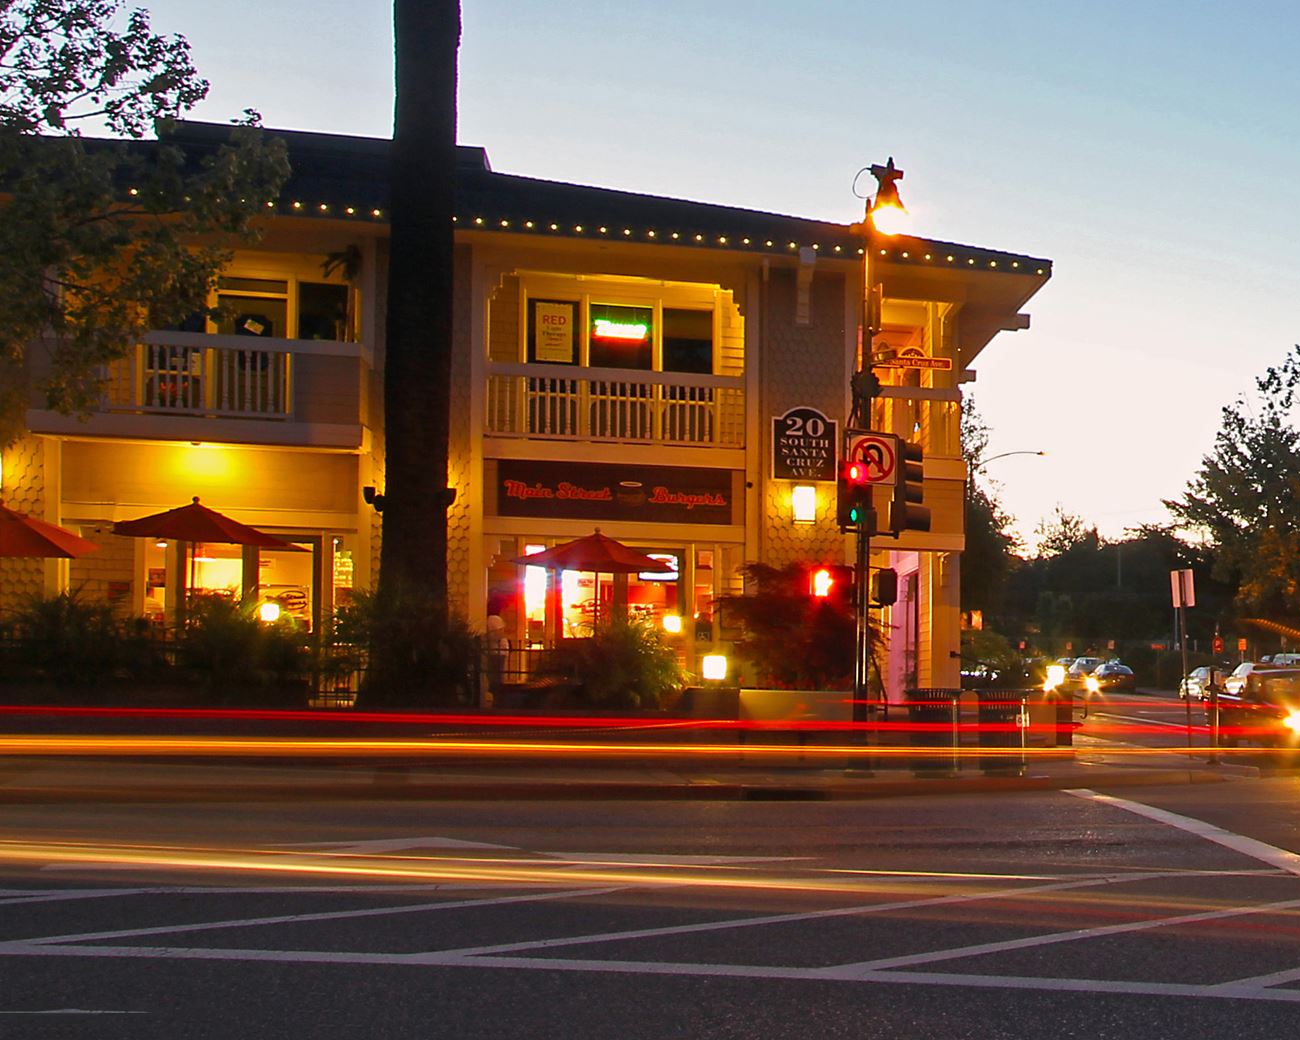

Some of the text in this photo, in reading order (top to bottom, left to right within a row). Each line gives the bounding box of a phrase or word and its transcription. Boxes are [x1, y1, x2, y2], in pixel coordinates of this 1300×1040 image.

[543, 314, 566, 325] RED
[912, 359, 929, 367] Cruz
[785, 417, 825, 437] 20
[780, 438, 829, 448] SOUTH
[781, 448, 828, 458] SANTA
[786, 457, 825, 468] CRUZ
[792, 468, 822, 477] AVE.
[504, 479, 728, 509] Main Street Burgers
